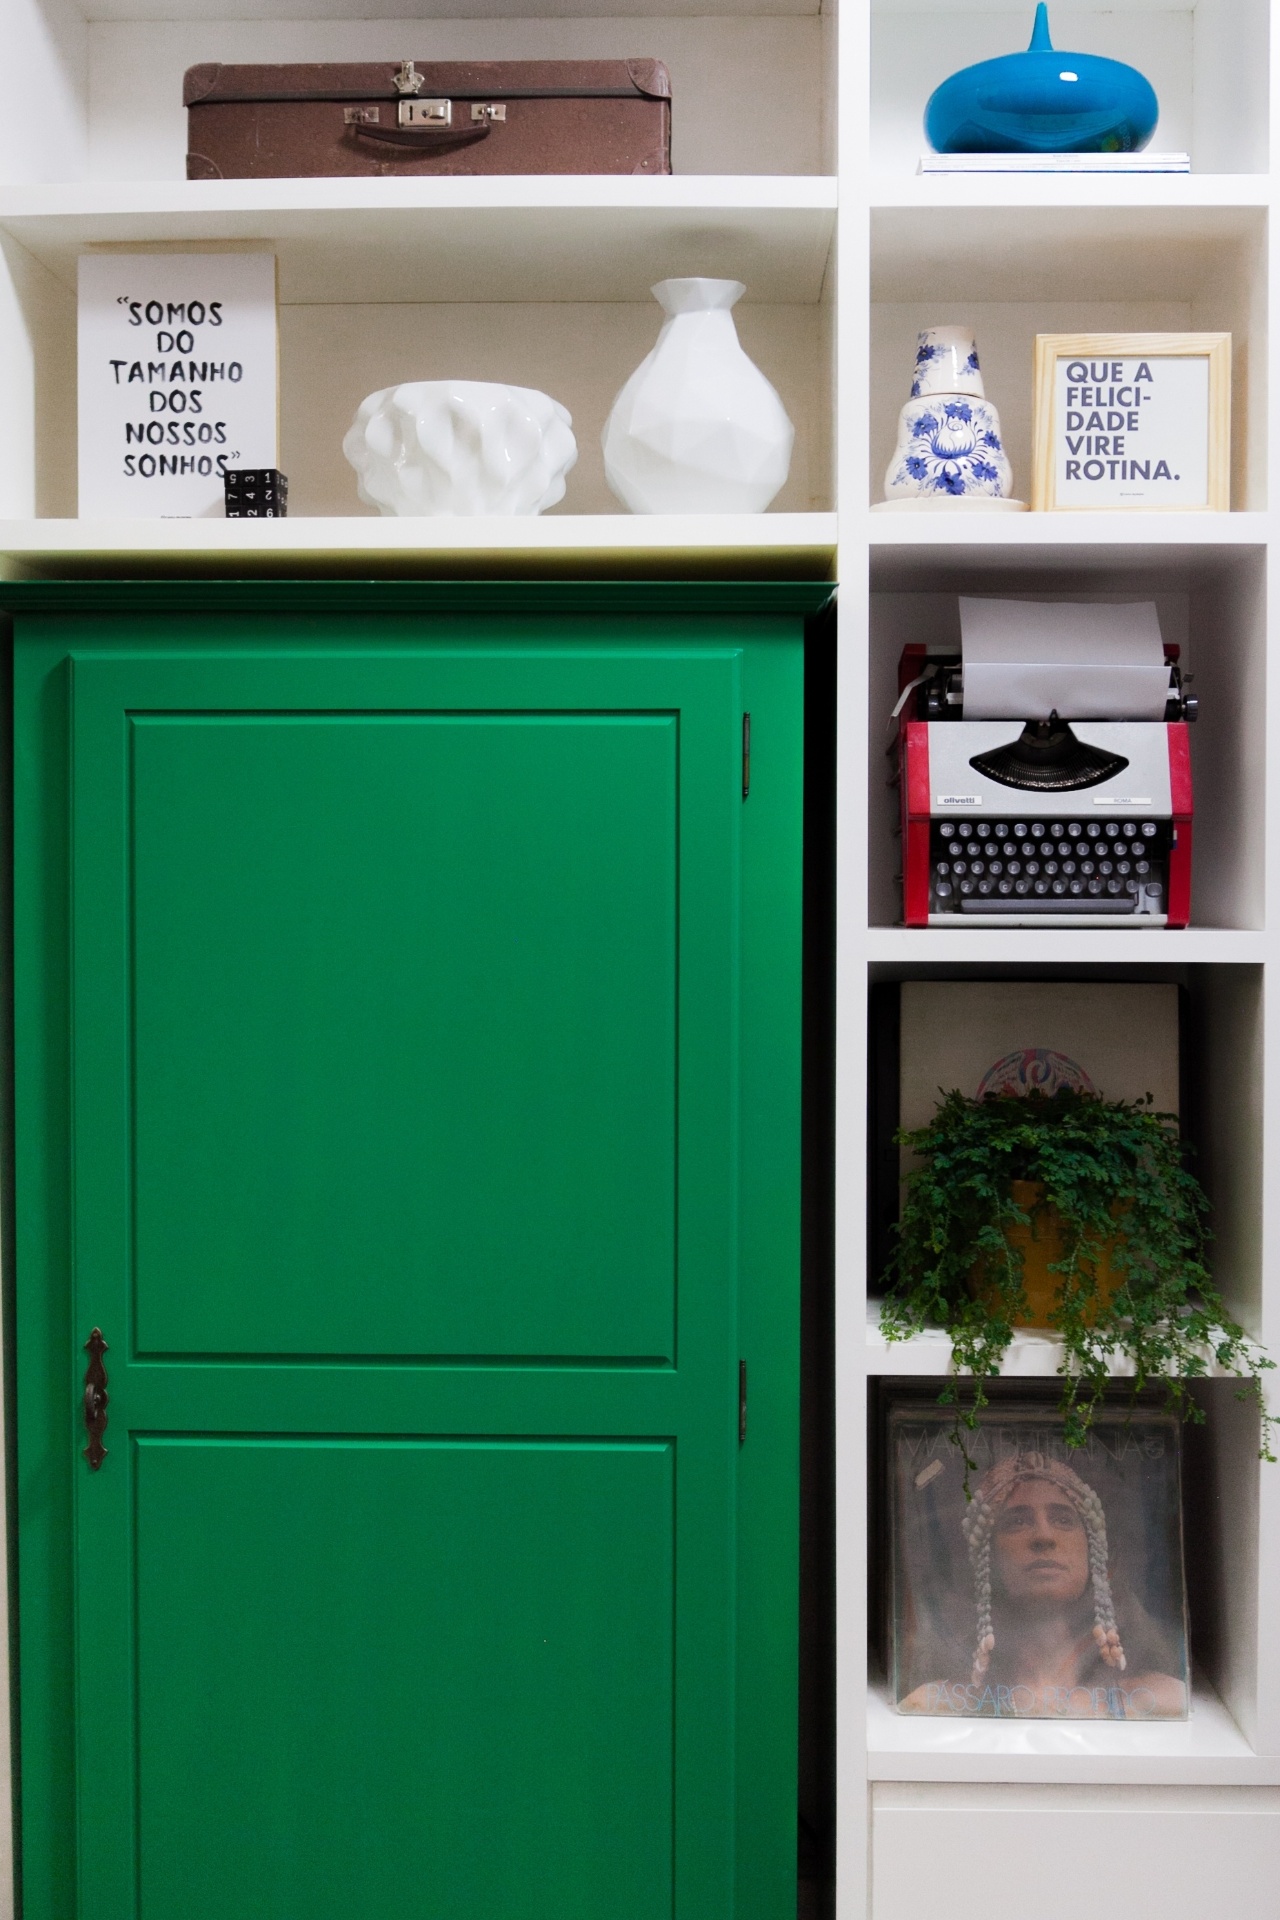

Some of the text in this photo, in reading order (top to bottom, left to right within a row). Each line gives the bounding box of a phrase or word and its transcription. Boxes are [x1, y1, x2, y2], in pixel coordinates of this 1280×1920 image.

[157, 329, 195, 355] DO
[109, 359, 243, 385] TAMANHO
[1066, 361, 1154, 384] QUE A
[149, 388, 203, 414] DOS
[1066, 386, 1152, 408] FELICI-
[1066, 410, 1139, 432] DADE
[125, 420, 227, 447] NOSSOS
[1064, 435, 1125, 456] VIRE
[229, 472, 271, 484] 5 3 1
[1065, 459, 1182, 481] ROTINA.
[245, 492, 256, 500] 4
[265, 490, 273, 501] 2
[943, 796, 975, 805] olivetti
[926, 1679, 1036, 1714] PÁSSARO
